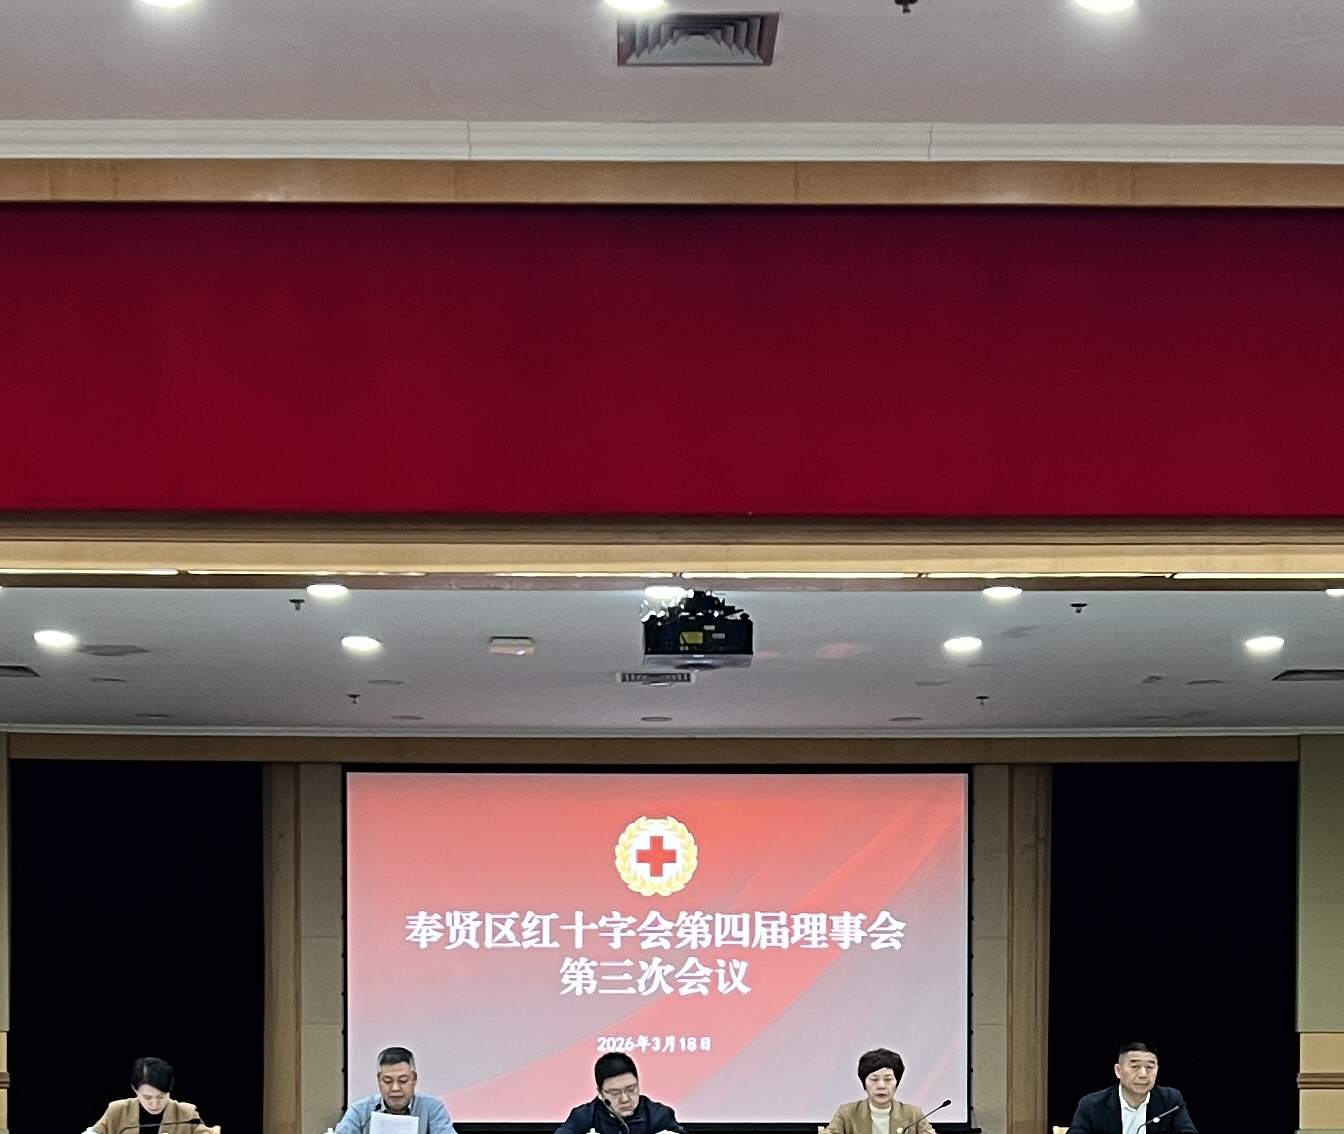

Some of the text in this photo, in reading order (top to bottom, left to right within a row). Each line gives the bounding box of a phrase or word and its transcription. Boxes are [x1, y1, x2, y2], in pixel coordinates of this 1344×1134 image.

[405, 910, 907, 950] 奉贤区红十字会第四届理事会
[559, 956, 752, 996] 第三次会议
[596, 1034, 712, 1053] 2026年3月18日
